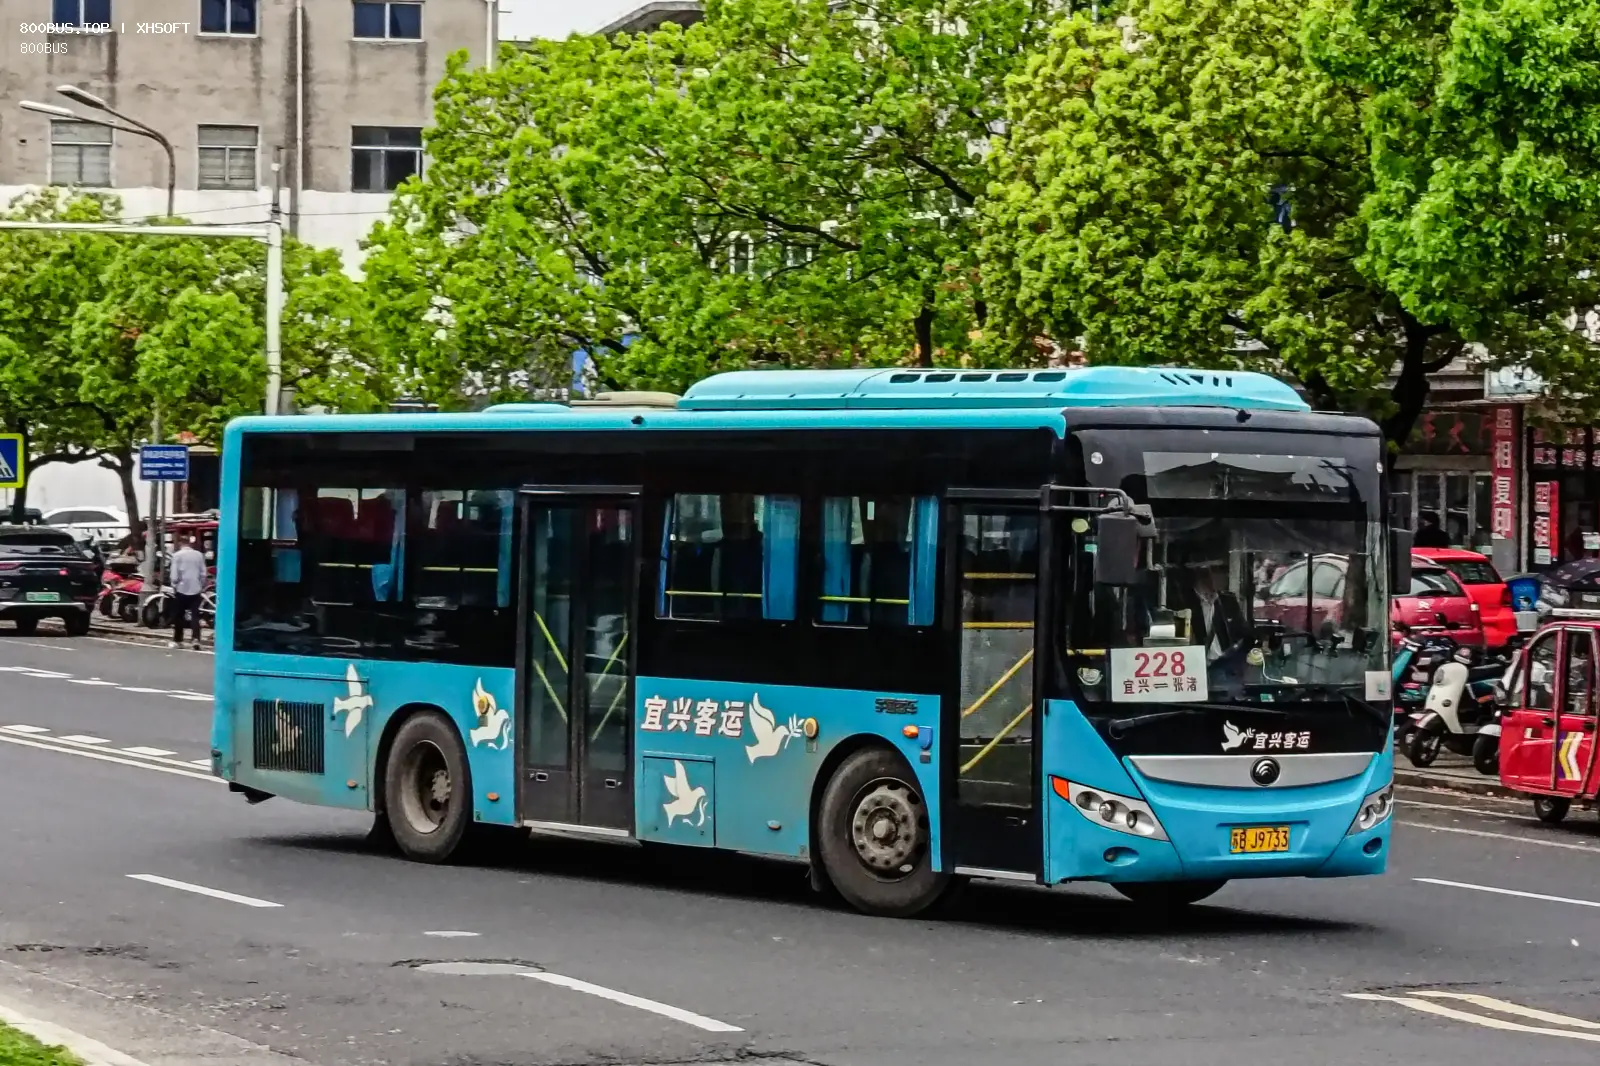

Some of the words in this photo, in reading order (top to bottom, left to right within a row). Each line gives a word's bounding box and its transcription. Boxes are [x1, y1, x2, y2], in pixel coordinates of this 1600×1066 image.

[1134, 651, 1186, 678] 228
[1123, 678, 1150, 695] 宜兴
[640, 694, 745, 738] 宜兴客运
[1252, 731, 1312, 750] 宜兴客运
